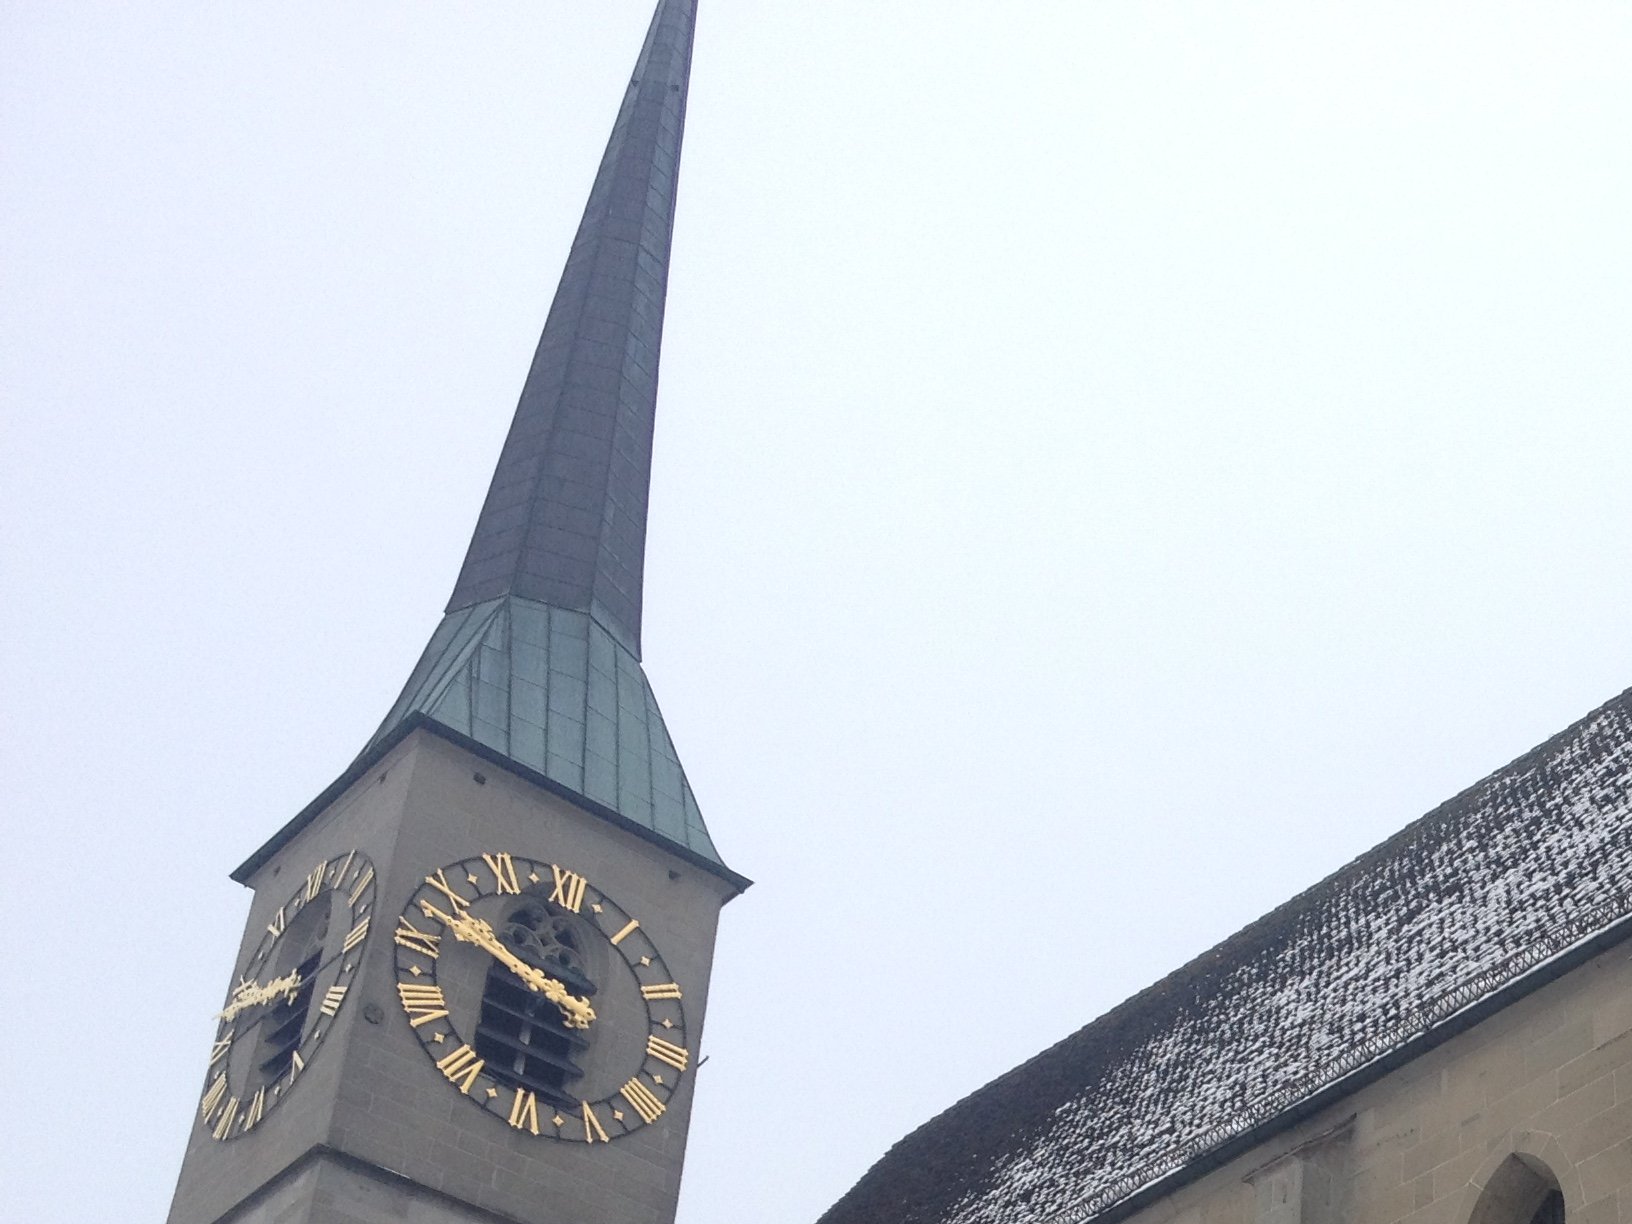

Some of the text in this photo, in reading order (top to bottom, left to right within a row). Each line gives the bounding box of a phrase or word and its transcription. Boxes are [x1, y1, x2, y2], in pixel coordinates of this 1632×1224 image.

[425, 868, 470, 914] X
[483, 852, 521, 895] XI
[548, 864, 588, 913] XII
[394, 915, 442, 959] IX
[610, 918, 641, 945] I
[397, 982, 449, 1028] VIII
[640, 982, 683, 1000] II
[436, 1043, 485, 1094] VII
[646, 1034, 689, 1071] III
[508, 1087, 539, 1136] VI
[582, 1100, 609, 1143] V
[620, 1077, 667, 1124] IIII
